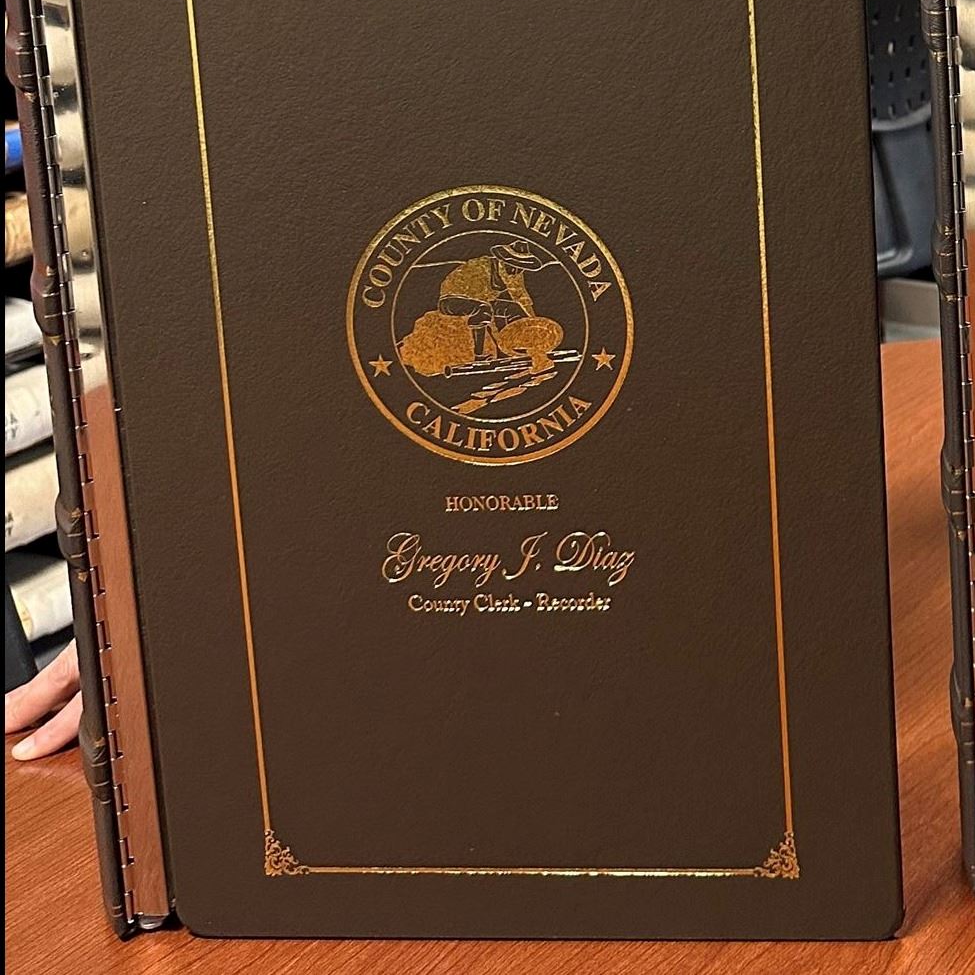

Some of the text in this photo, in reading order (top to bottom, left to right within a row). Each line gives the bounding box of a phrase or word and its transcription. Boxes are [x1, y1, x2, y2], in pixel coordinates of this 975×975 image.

[362, 198, 612, 309] COUNTY OF NEVADA
[405, 395, 593, 452] CALIFORNIA
[445, 494, 560, 513] HONORABLE
[381, 532, 501, 589] Gregory
[554, 531, 635, 587] Diaz
[408, 593, 471, 616] County
[473, 593, 521, 612] Clerk
[535, 592, 612, 612] Recorder
